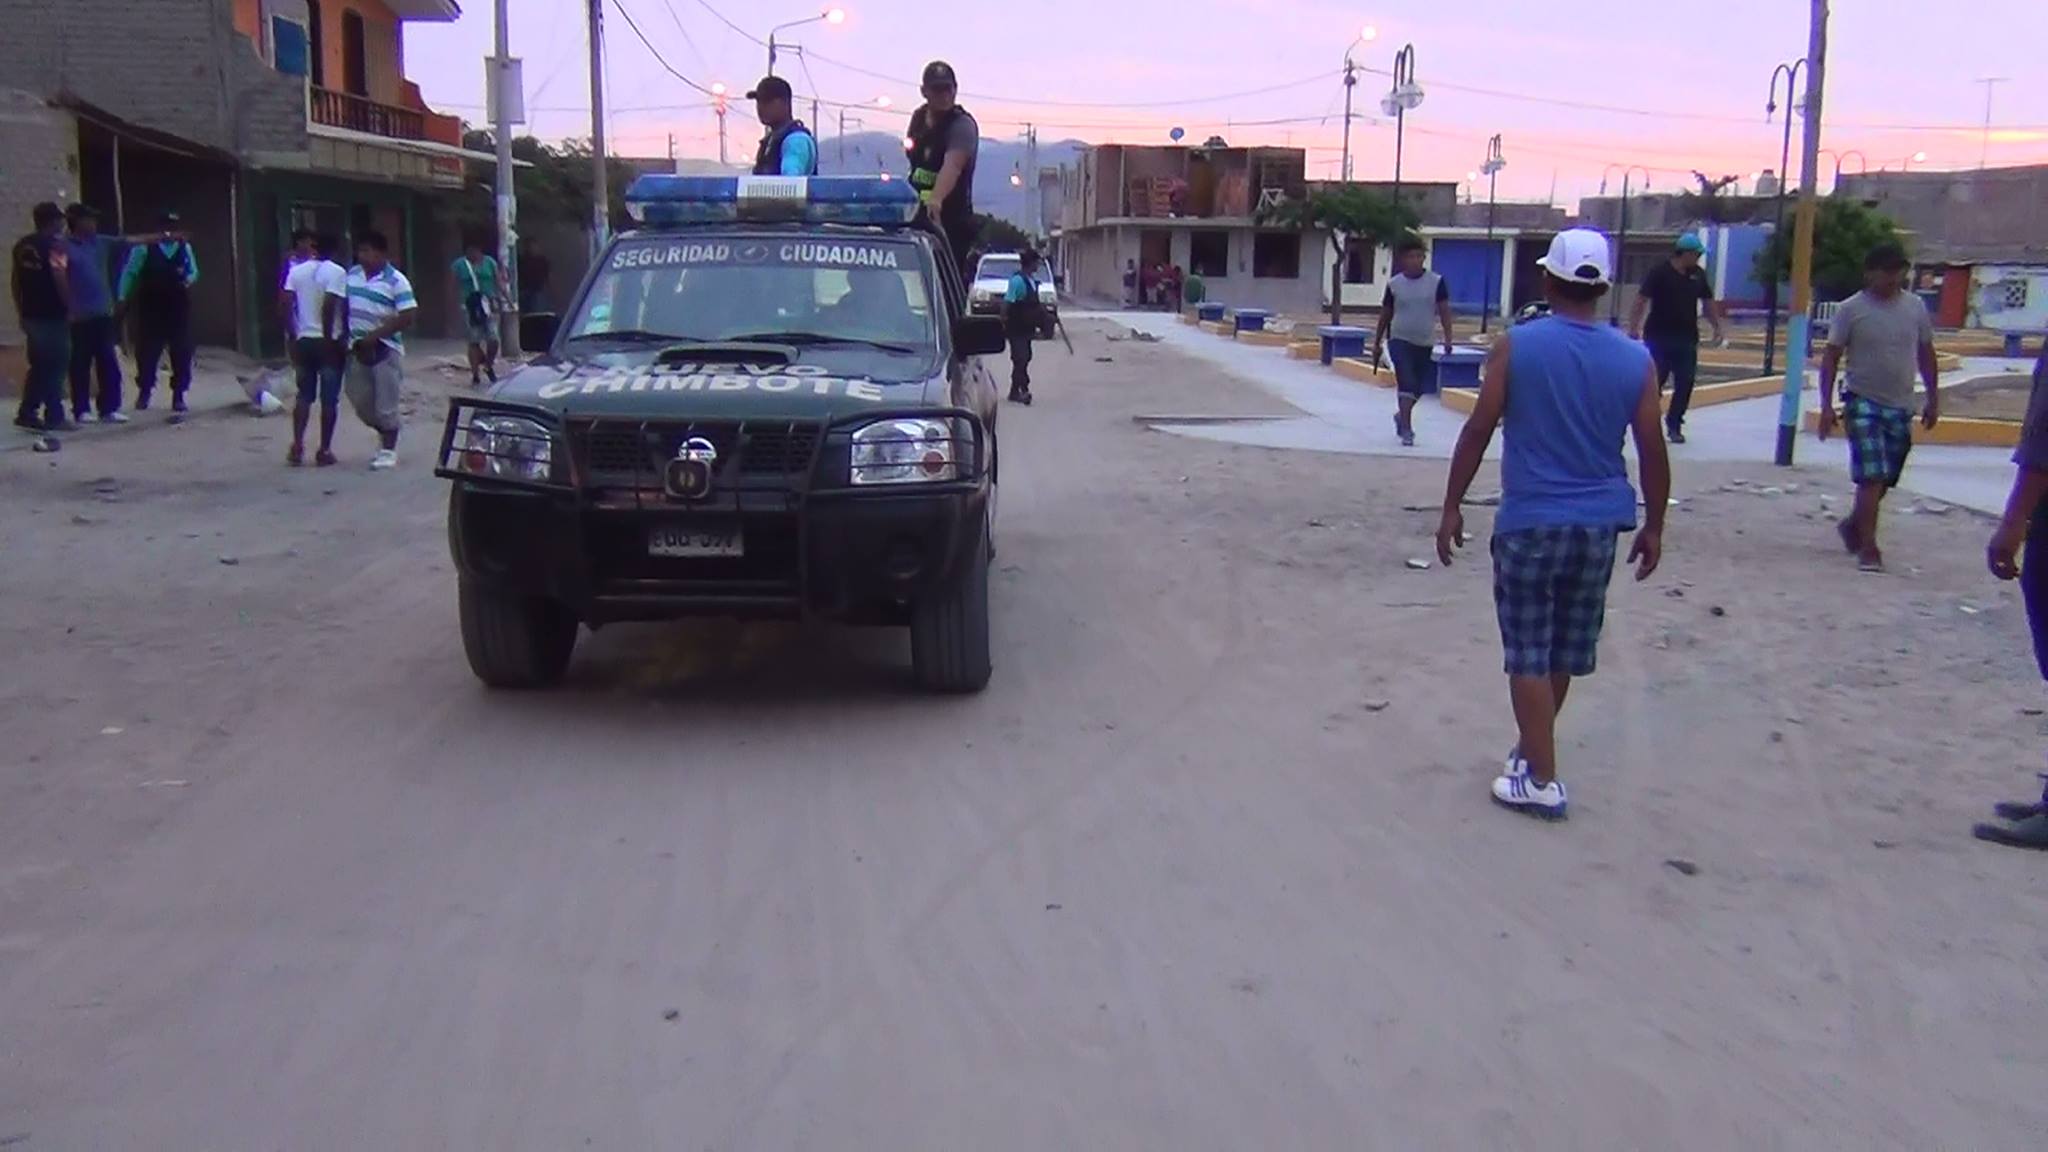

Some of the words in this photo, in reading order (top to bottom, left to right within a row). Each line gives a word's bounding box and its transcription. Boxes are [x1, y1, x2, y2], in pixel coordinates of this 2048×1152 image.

[612, 244, 730, 269] SEGURIDAD
[779, 244, 897, 268] CIUDADANA
[538, 374, 883, 401] CHIMBOTE
